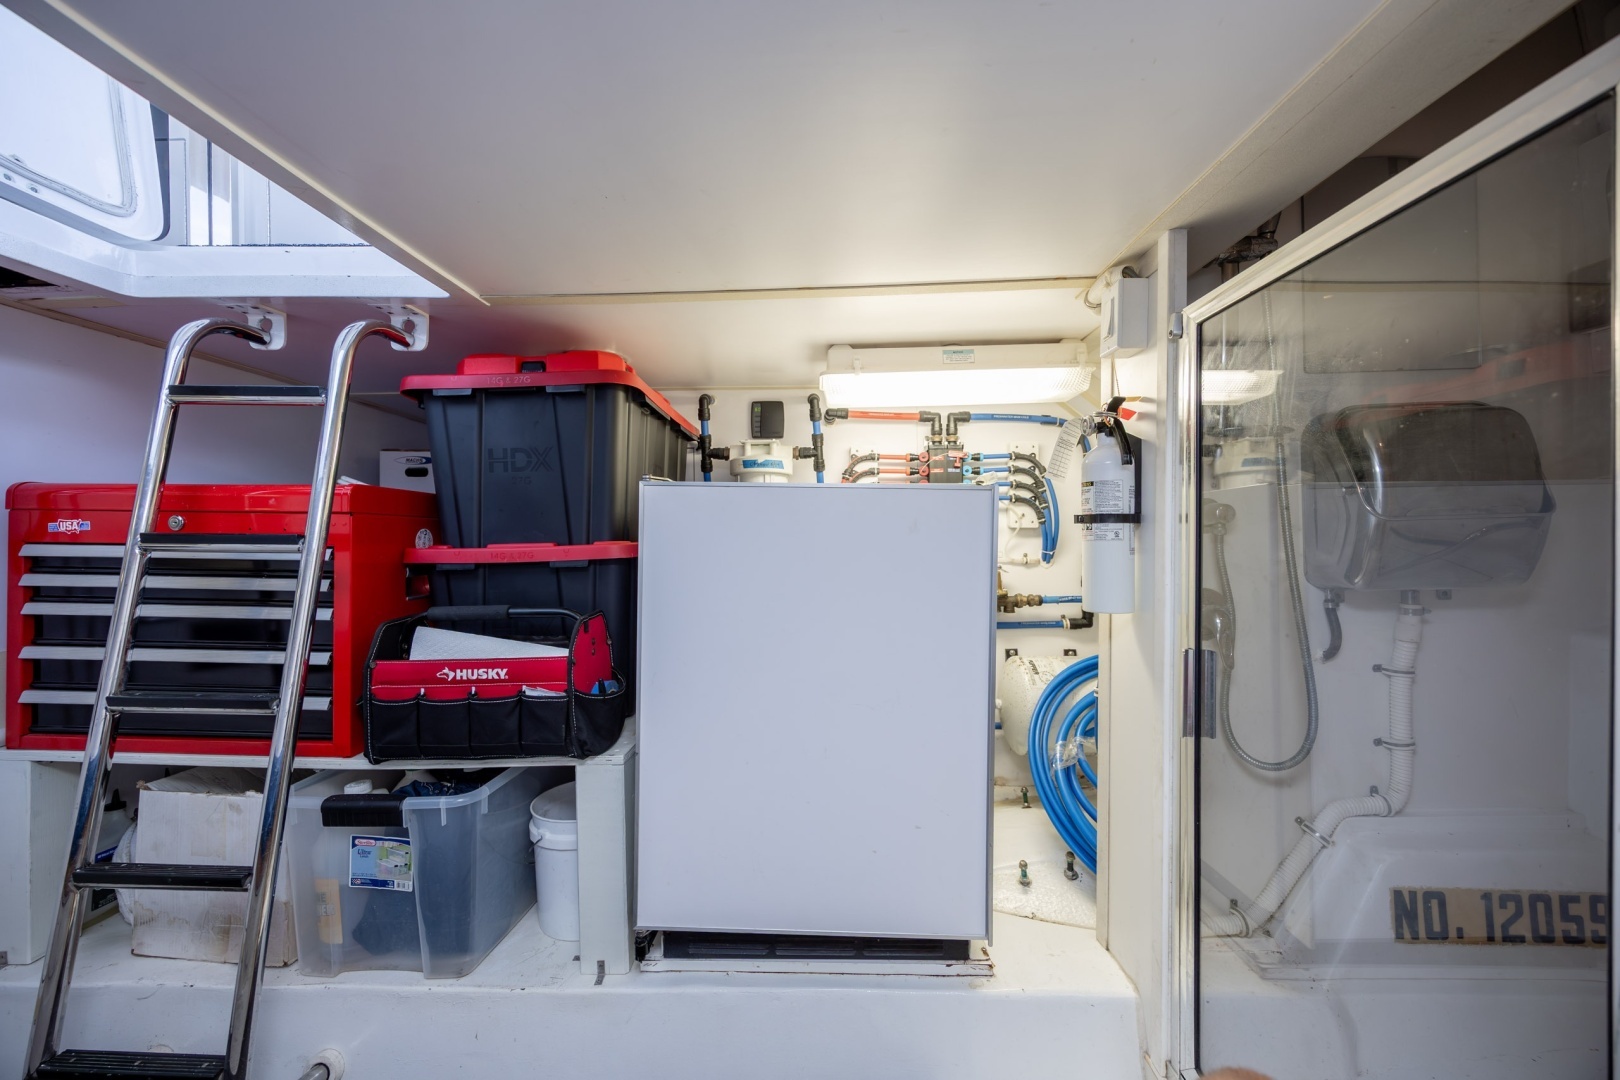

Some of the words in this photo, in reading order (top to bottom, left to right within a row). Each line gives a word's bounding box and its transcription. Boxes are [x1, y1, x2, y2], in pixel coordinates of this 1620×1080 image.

[513, 375, 531, 384] 27G
[487, 446, 554, 474] HDX
[60, 521, 79, 531] USA
[455, 668, 508, 680] HUSKY
[1393, 889, 1464, 941] NO.
[1479, 891, 1609, 945] 12059
